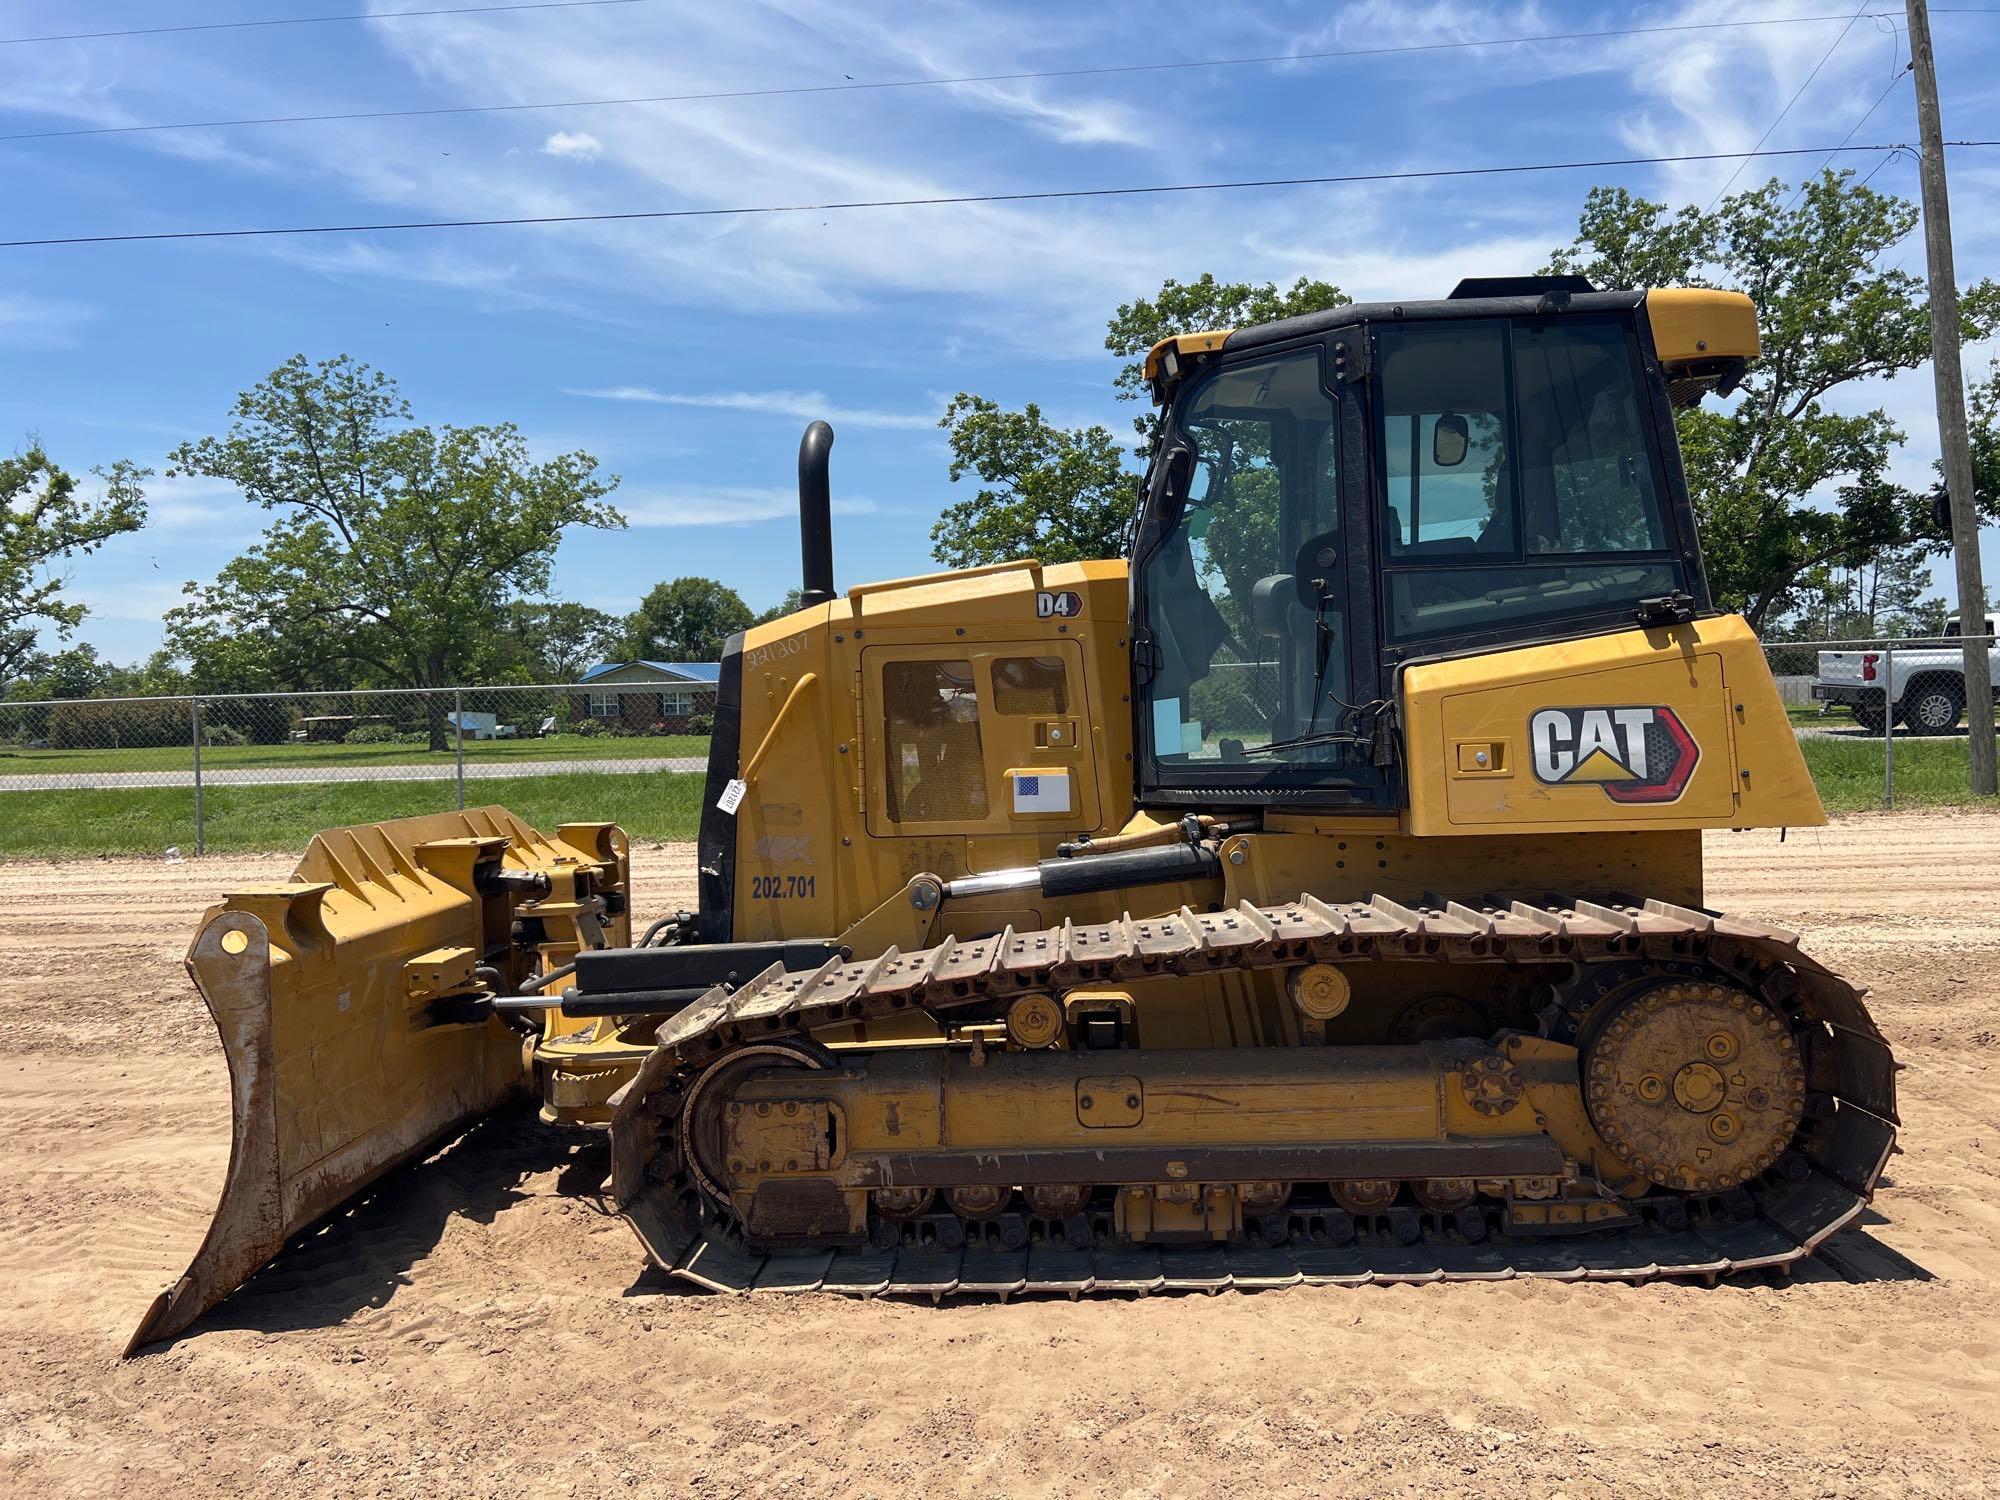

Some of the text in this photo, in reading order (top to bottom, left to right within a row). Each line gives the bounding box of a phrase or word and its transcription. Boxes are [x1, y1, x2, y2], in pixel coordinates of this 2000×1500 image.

[1037, 593, 1069, 617] D4
[747, 632, 808, 672] 221207
[1532, 708, 1654, 782] CAT
[752, 875, 815, 899] 202.701
